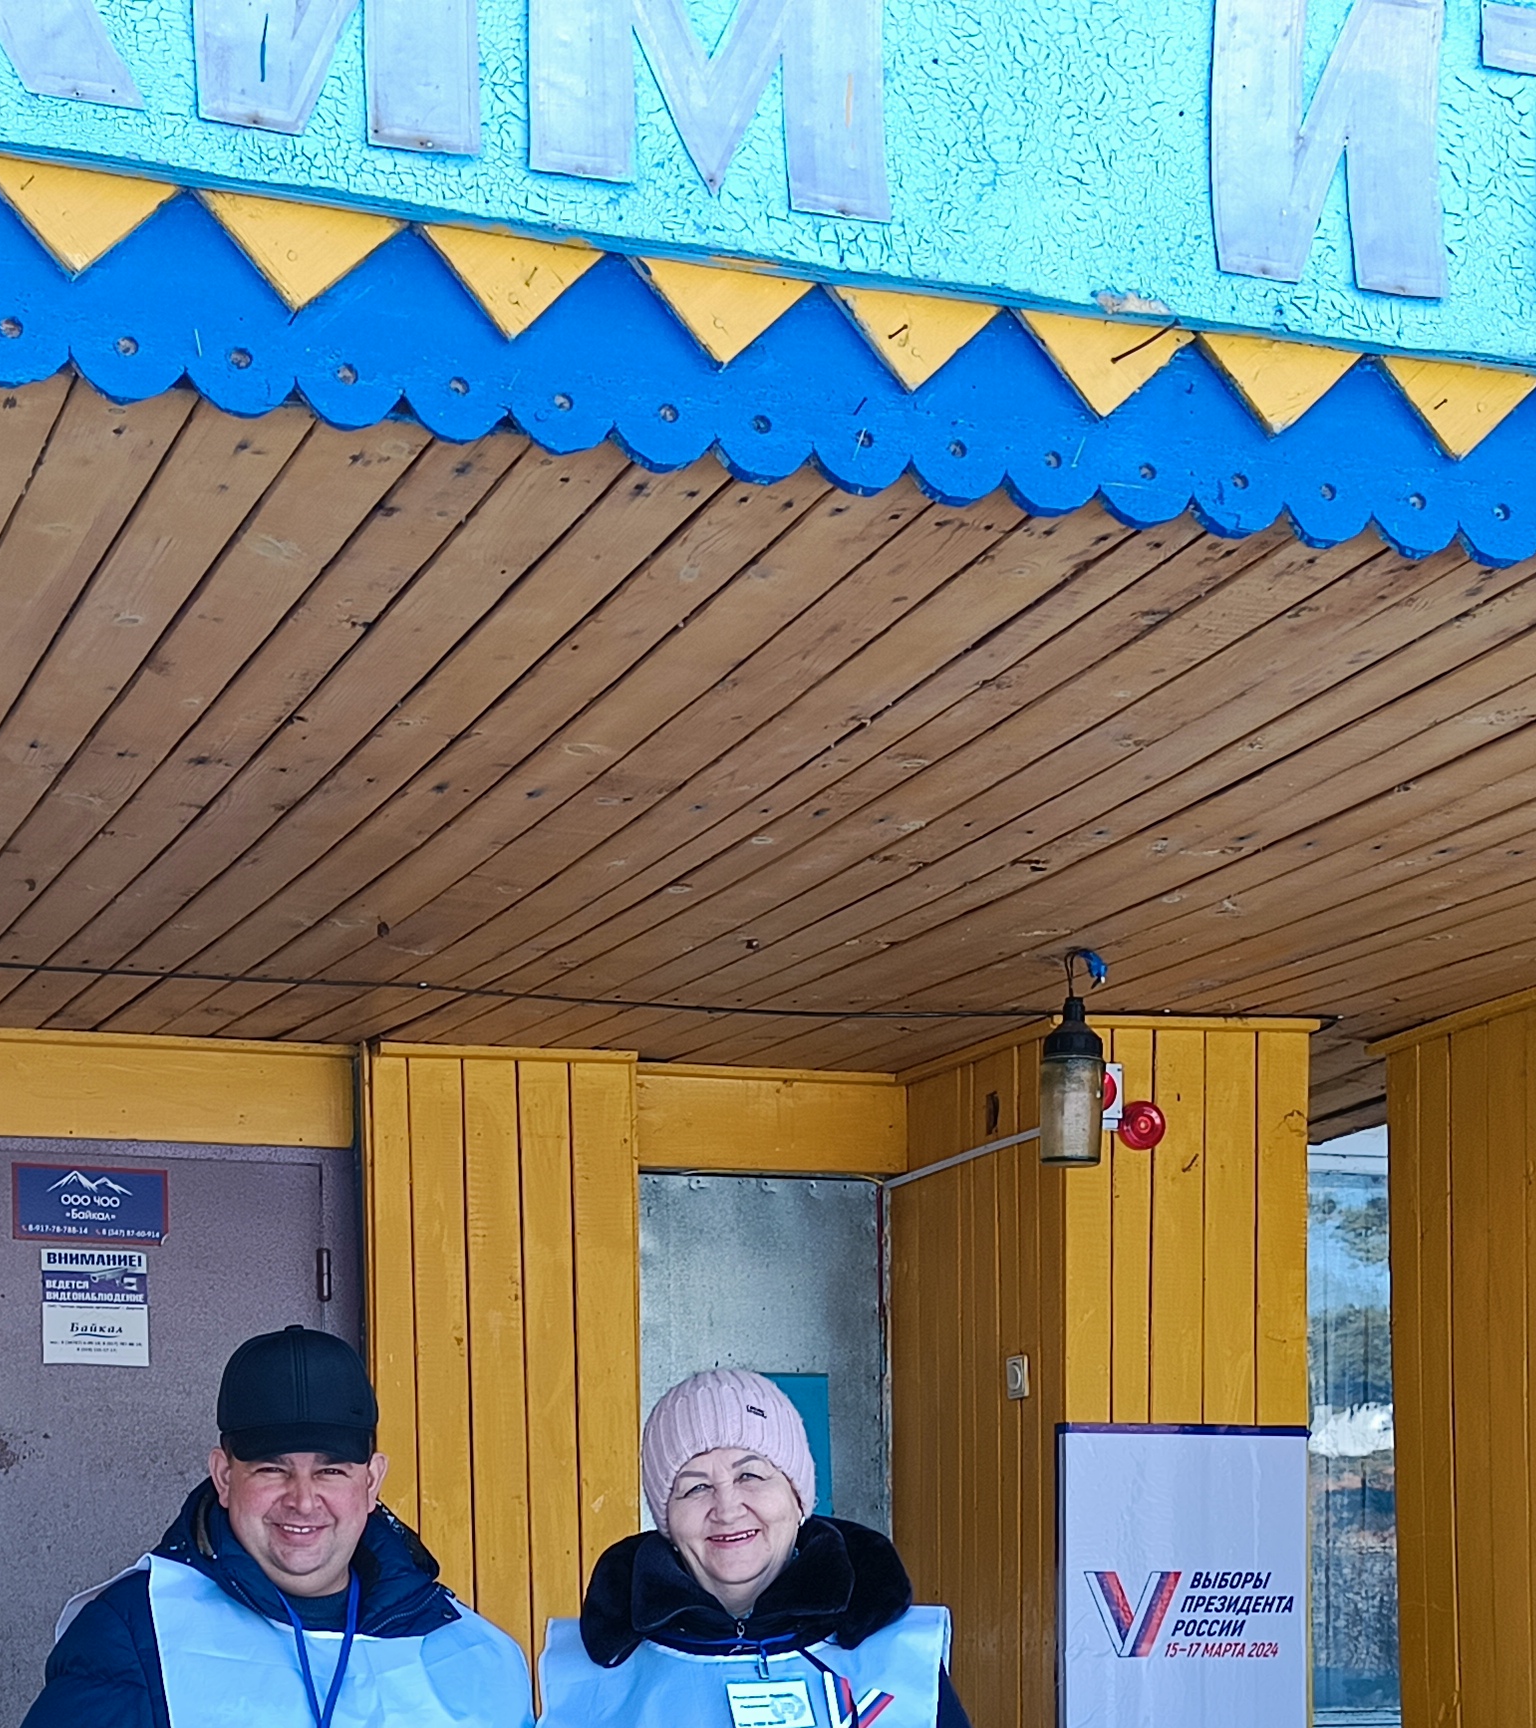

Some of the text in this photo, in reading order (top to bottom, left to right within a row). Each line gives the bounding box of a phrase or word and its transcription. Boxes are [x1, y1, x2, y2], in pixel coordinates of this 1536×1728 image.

[61, 1194, 120, 1207] ООО ЧОО
[47, 1252, 142, 1267] ВНИМАНИЕ!
[46, 1279, 89, 1290] ВЕДЕТСЯ
[46, 1292, 144, 1303] ВИДЕОНАБЛЮДЕНИЕ
[70, 1322, 123, 1334] Байкал
[1189, 1572, 1271, 1589] ВЫБОРЫ
[1180, 1595, 1293, 1615] ПРЕЗИДЕНТА
[1171, 1620, 1246, 1637] РОССИИ
[1201, 1643, 1246, 1658] МАРТА
[1248, 1643, 1278, 1657] 2024
